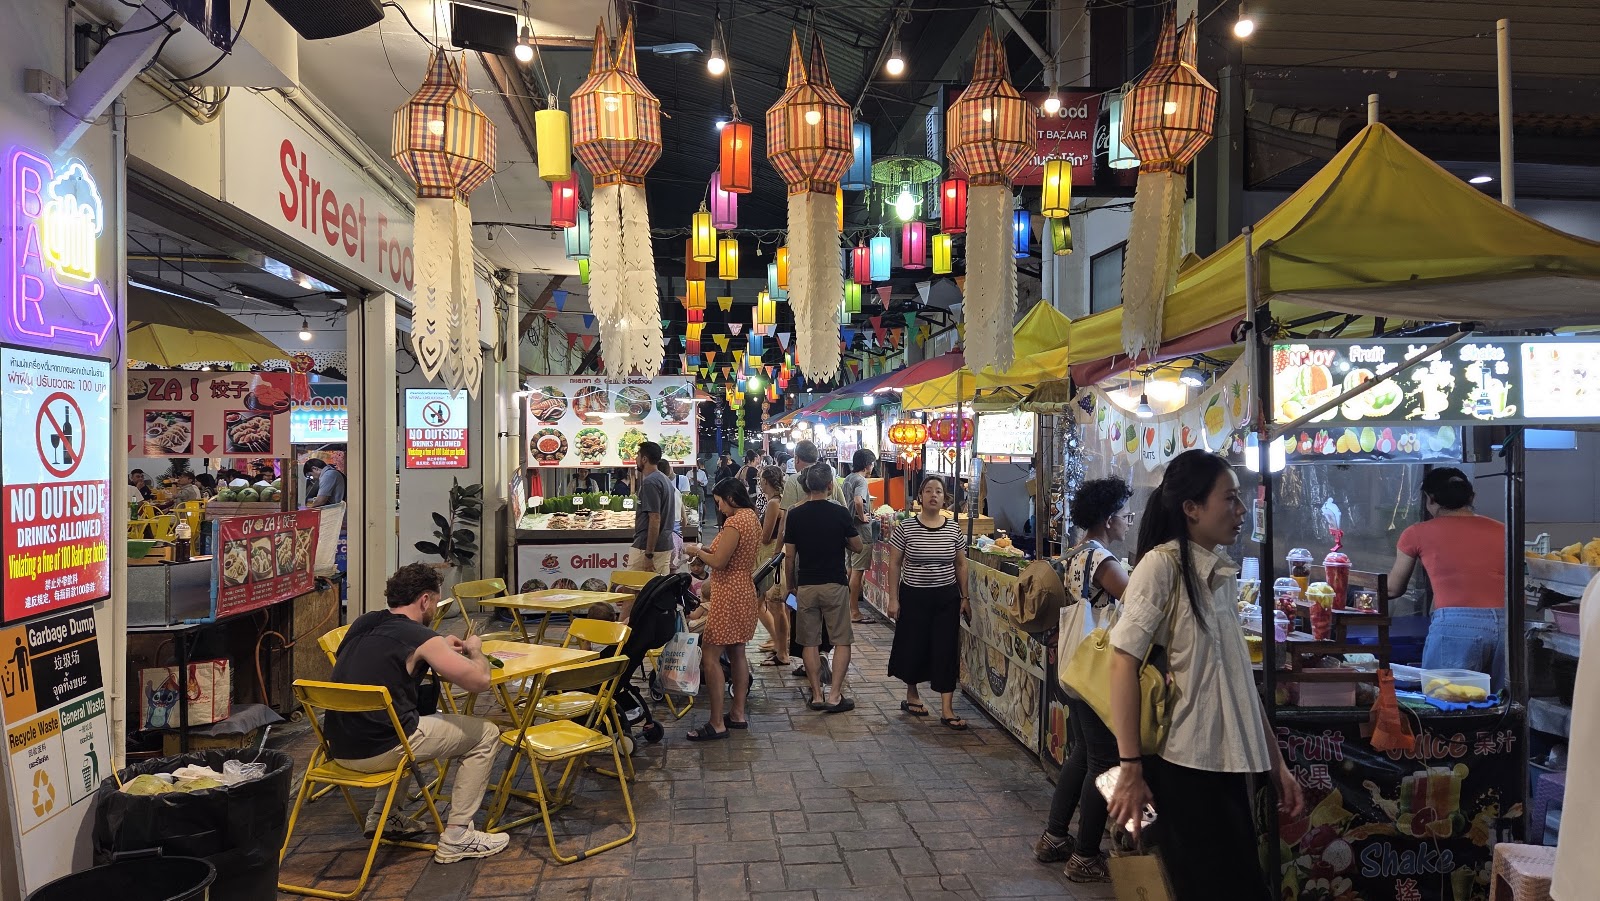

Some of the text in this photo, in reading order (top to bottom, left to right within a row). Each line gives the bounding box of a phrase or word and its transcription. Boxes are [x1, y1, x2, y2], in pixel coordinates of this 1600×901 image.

[1059, 104, 1088, 118] ood
[1046, 130, 1087, 139] BAZAAR
[279, 138, 415, 291] Street Foo
[21, 165, 46, 326] BAR
[1349, 345, 1385, 362] Fruit
[1460, 344, 1505, 361] Shake
[79, 379, 93, 392] 100
[209, 379, 250, 399] 饺子
[291, 395, 347, 411] OCONU
[409, 429, 464, 440] NO OUTSIDE
[10, 484, 105, 523] NO OUTSIDE
[17, 518, 101, 548] DRINKS ALLOWED
[9, 540, 107, 581] Violating a fine of 100 Baht per bottle
[571, 553, 617, 569] Grilled
[28, 617, 95, 647] Garbage Dump
[52, 671, 88, 701] จุดทิ้งขยะ
[61, 697, 105, 726] General Waste
[9, 717, 59, 749] Recycle Waste
[1275, 726, 1345, 761] Fruit
[1473, 729, 1516, 755] 果汁
[1290, 764, 1333, 790] 水果
[1361, 841, 1455, 878] Shake
